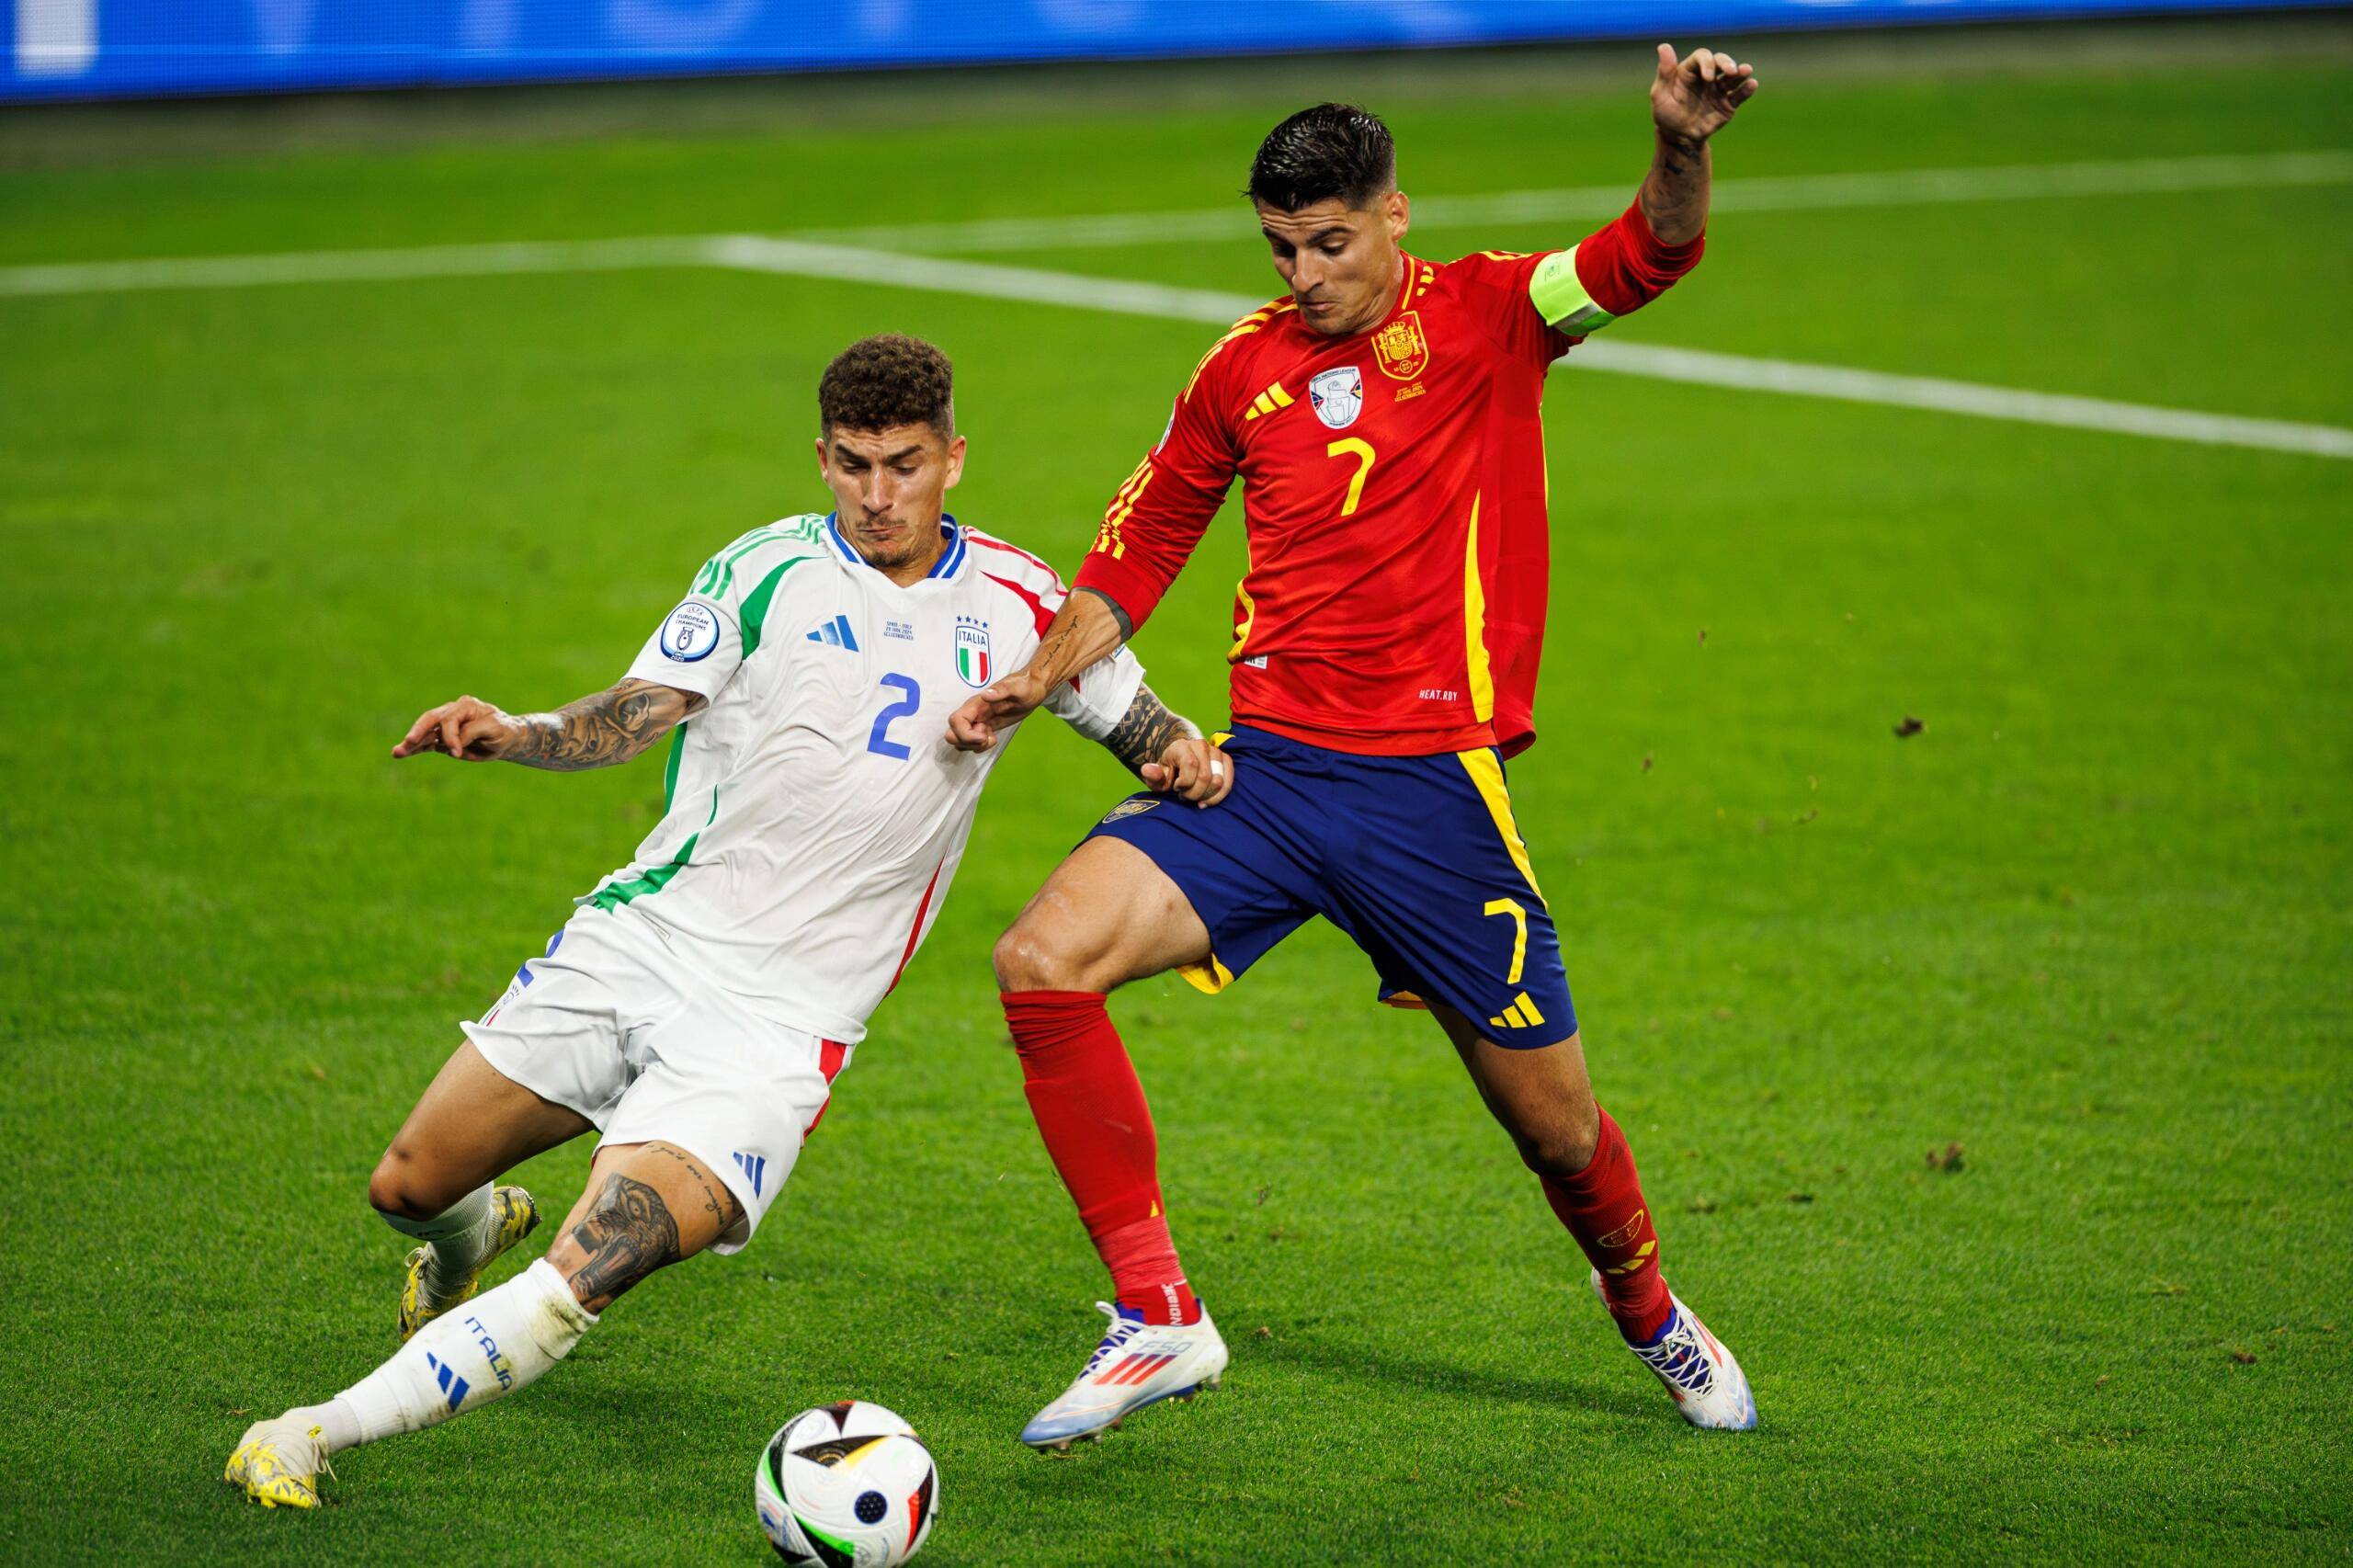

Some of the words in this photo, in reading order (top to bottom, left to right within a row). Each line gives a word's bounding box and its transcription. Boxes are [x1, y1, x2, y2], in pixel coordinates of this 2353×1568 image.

[1327, 437, 1376, 517] 7
[676, 620, 707, 631] CHAMPIONS
[677, 614, 709, 625] EUROPEAN
[959, 630, 986, 646] ITALIA
[1419, 689, 1458, 701] HEAT.RDY
[867, 672, 920, 761] 2
[1484, 898, 1528, 984] 7
[465, 1316, 514, 1392] ITALIA
[1137, 1341, 1193, 1353] F50
